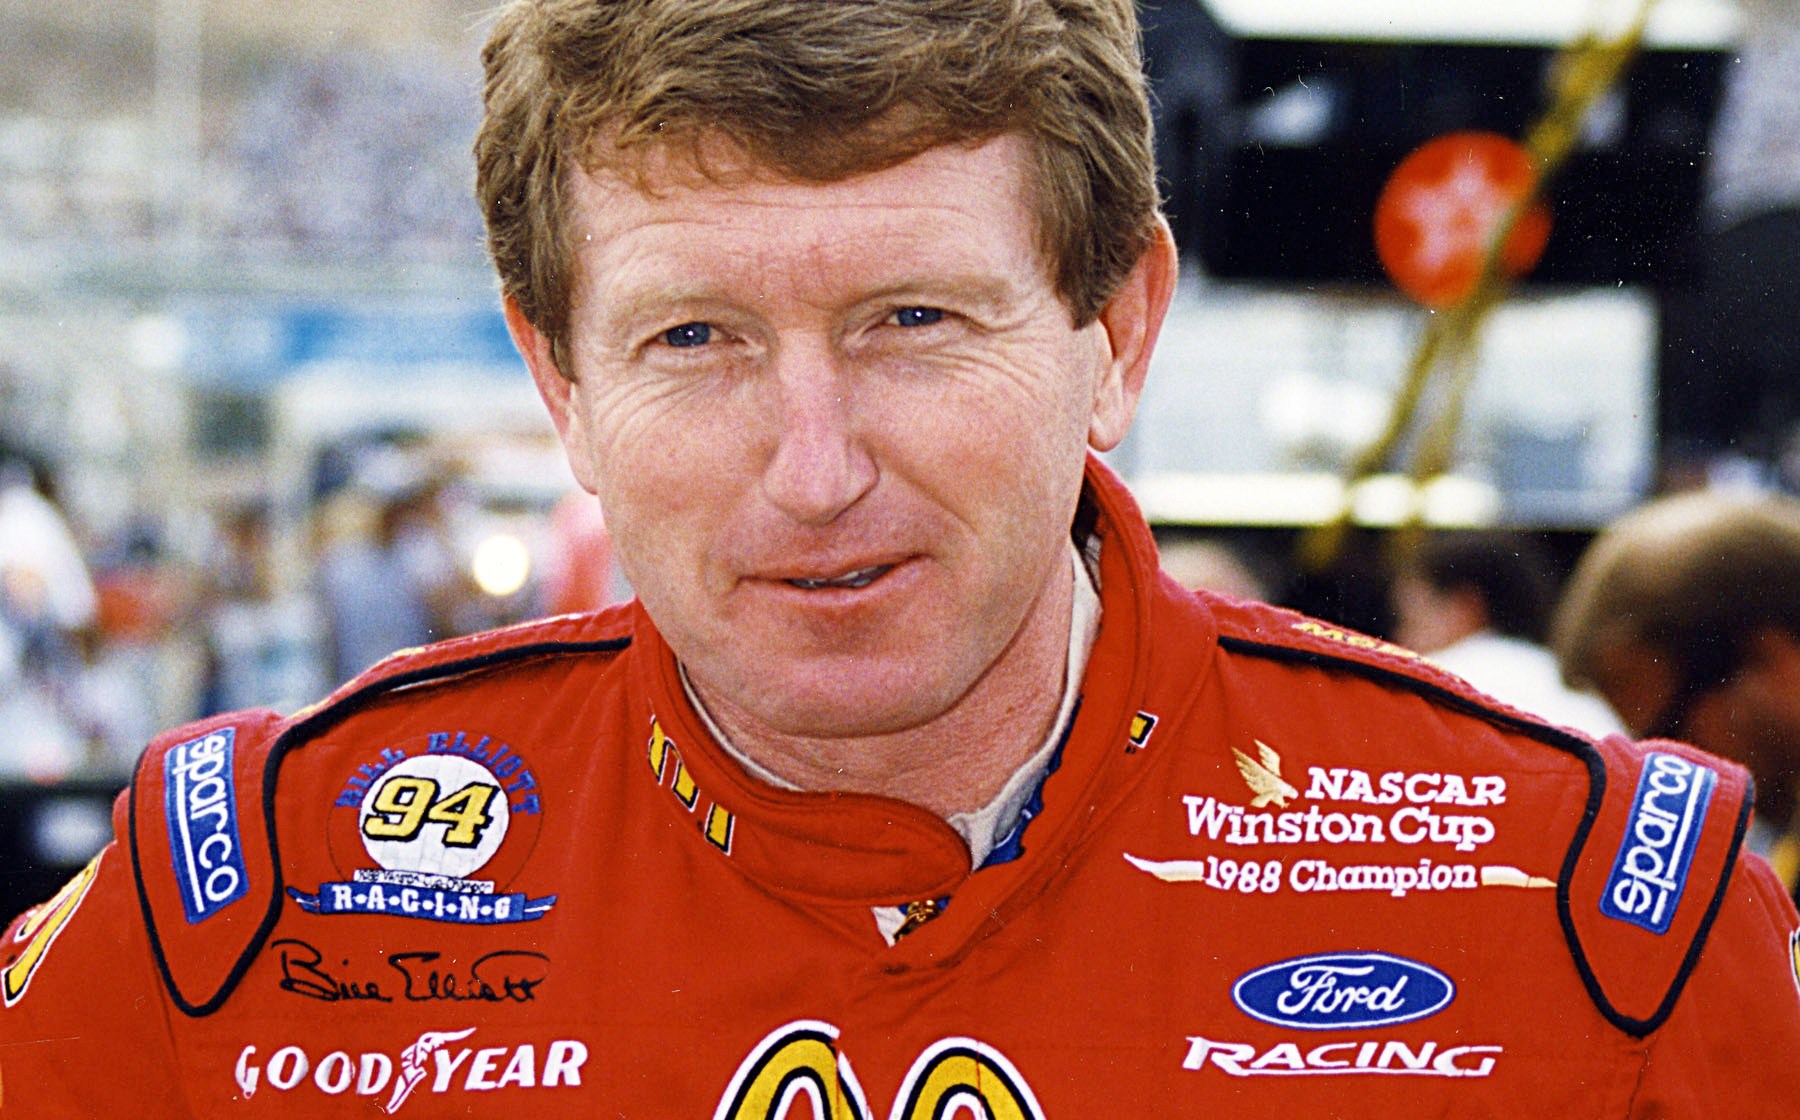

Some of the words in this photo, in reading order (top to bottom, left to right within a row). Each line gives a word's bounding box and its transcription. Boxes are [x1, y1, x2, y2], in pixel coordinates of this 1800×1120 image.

[335, 748, 406, 808] BILL
[427, 731, 541, 815] ELLIOTT
[1304, 766, 1507, 806] NASCAR
[172, 734, 240, 902] sparco
[362, 775, 501, 849] 94
[1182, 795, 1386, 845] Winston
[1388, 806, 1496, 851] Cup
[1613, 755, 1692, 915] sparco
[1204, 856, 1283, 893] 1988
[1289, 858, 1478, 897] Champion
[1277, 965, 1409, 1014] Ford
[1182, 1036, 1503, 1077] RACING
